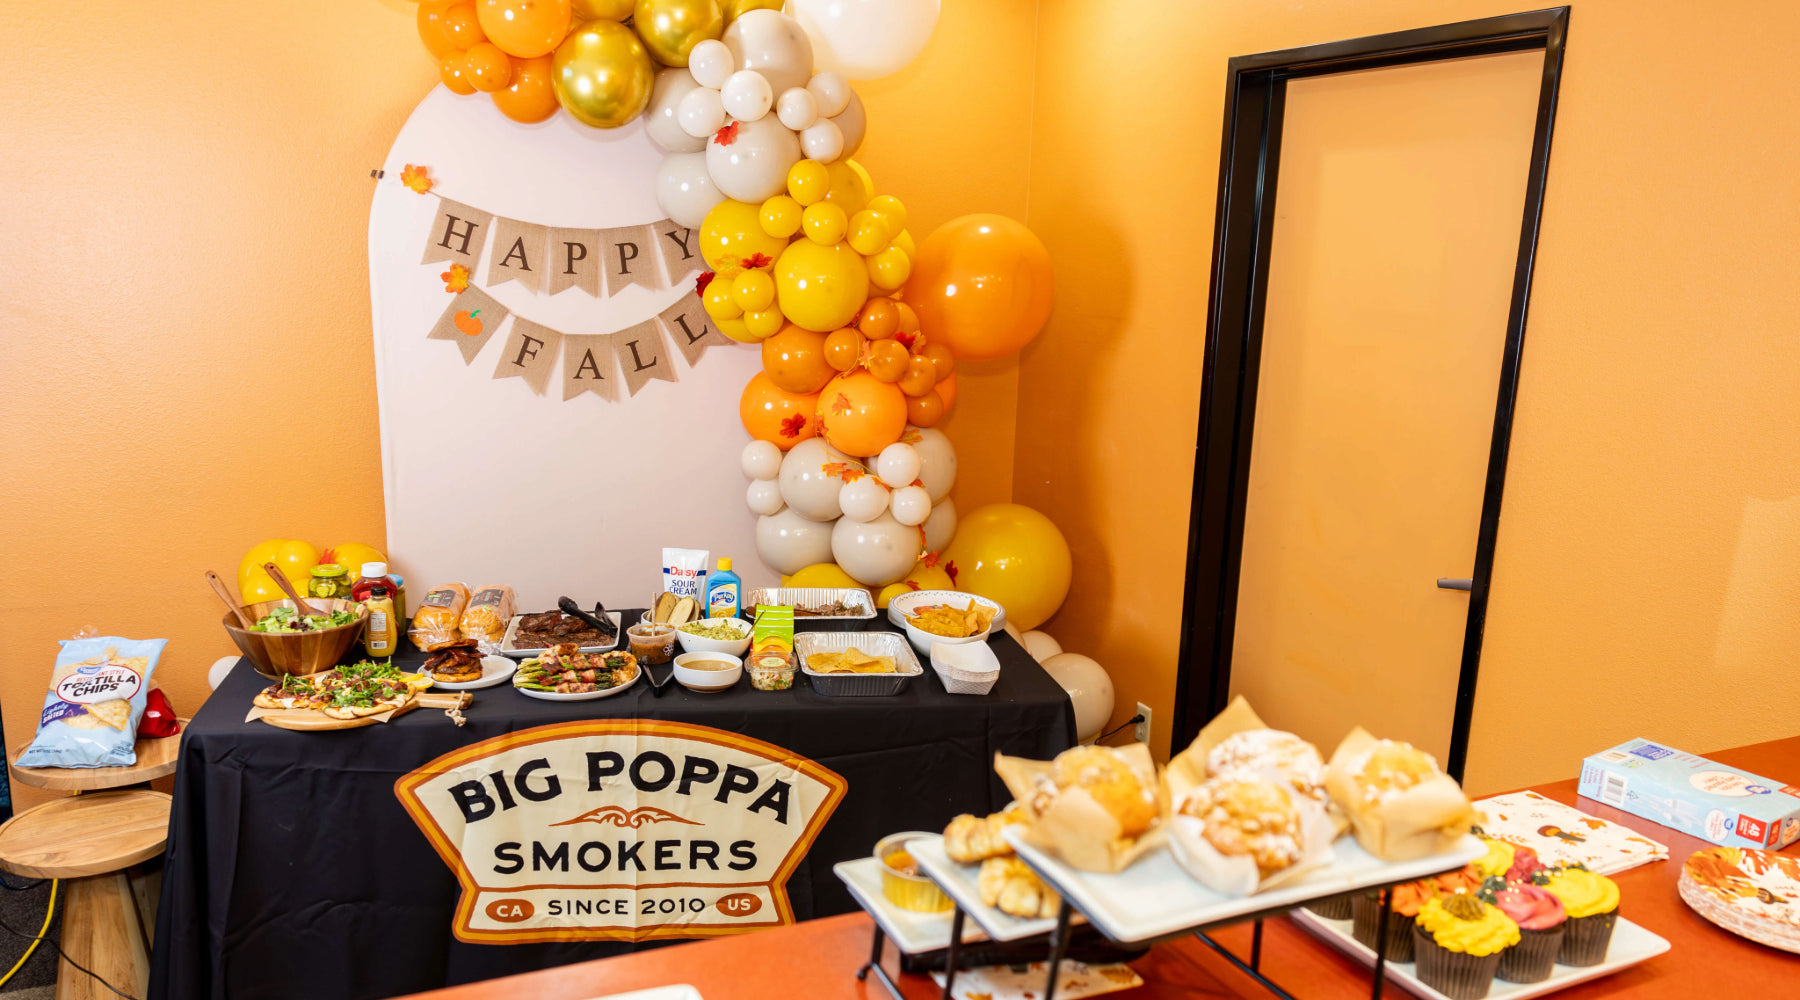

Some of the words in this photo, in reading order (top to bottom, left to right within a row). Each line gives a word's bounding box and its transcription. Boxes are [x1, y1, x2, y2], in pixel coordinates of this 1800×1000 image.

[437, 213, 694, 275] HAPPY
[511, 312, 709, 381] FALL
[671, 566, 697, 579] Dasy
[669, 586, 698, 596] CREAM
[672, 579, 696, 588] SOUR
[72, 682, 120, 697] CHIPS
[447, 757, 563, 825] BIG
[585, 750, 793, 825] POPPA
[493, 839, 758, 875] SMOKERS
[496, 904, 523, 918] CA
[548, 898, 629, 916] SINCE
[641, 897, 706, 915] 2010
[727, 898, 751, 911] US
